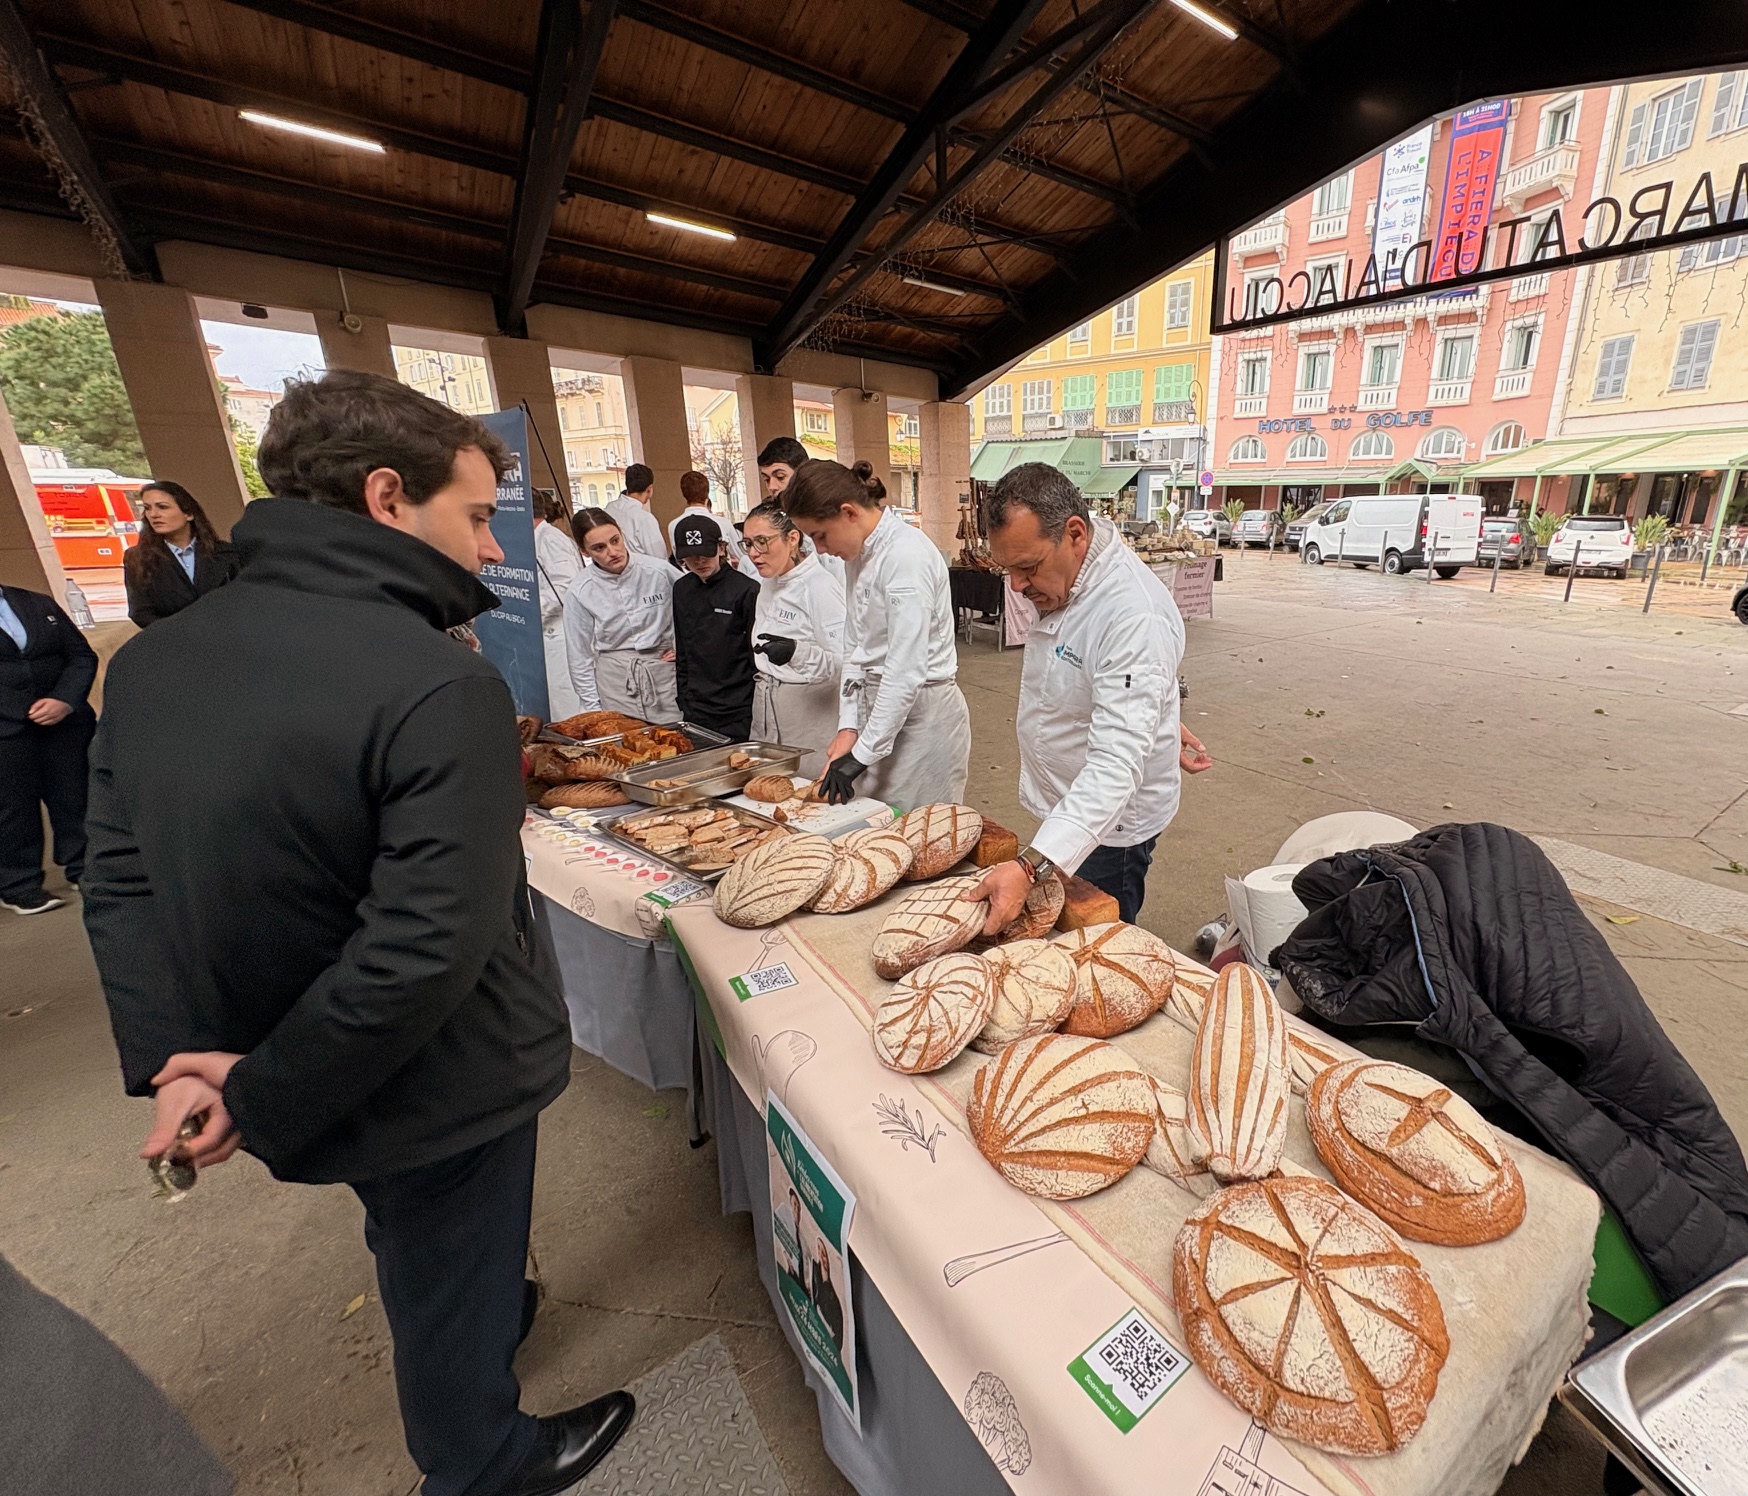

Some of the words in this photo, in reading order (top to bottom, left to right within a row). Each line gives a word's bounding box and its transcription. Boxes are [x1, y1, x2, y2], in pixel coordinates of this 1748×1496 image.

[1400, 163, 1419, 174] Afpa
[1464, 174, 1488, 242] FIERA
[1258, 418, 1316, 434] HOTEL
[1330, 418, 1352, 430] DU
[1366, 410, 1434, 428] GOLFE
[487, 565, 497, 577] DE
[497, 566, 535, 583] FORMATION
[489, 583, 530, 601] ALTERNANCE
[1084, 1374, 1118, 1412] Scanne-moi
